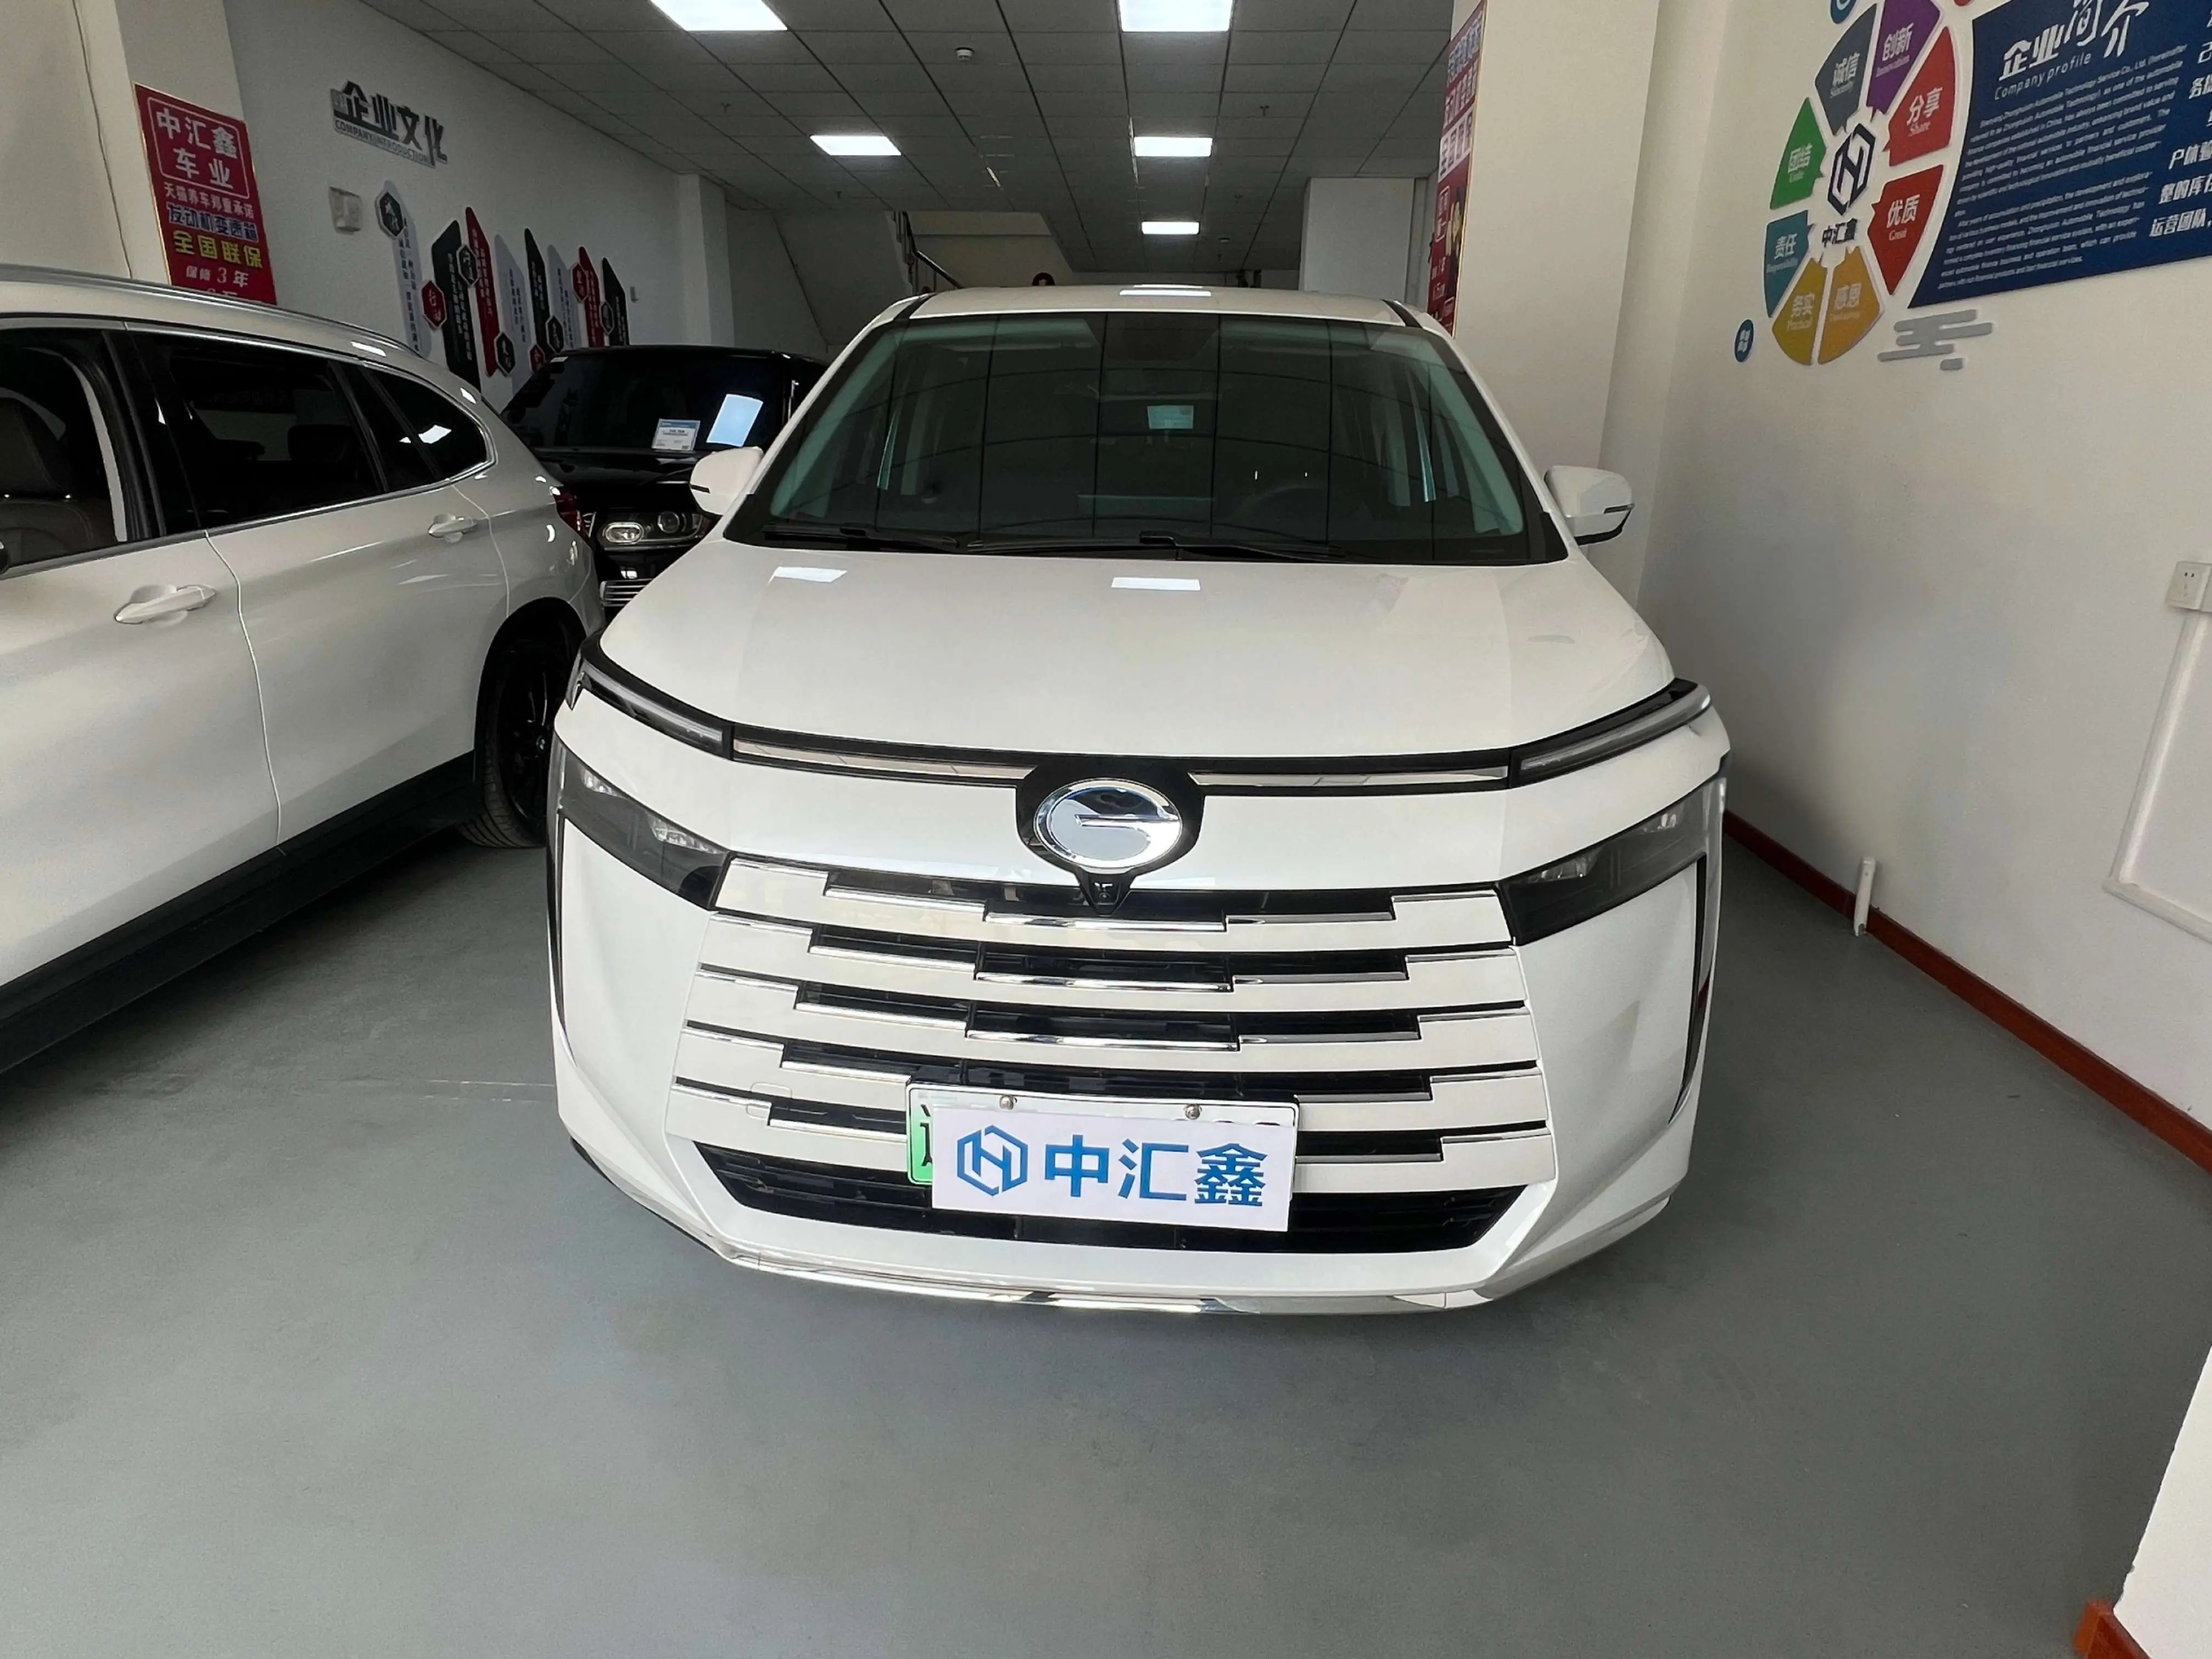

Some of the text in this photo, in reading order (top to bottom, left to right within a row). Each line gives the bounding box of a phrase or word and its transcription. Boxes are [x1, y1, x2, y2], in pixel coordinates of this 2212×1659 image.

[1882, 22, 1914, 61] 创新
[1999, 0, 2149, 81] 企业简介
[1832, 52, 1860, 88] 诚信
[1994, 53, 2091, 100] Company profile
[342, 81, 447, 166] 企业文化
[1906, 87, 1943, 126] 分享
[156, 108, 238, 159] 中汇鑫
[335, 120, 373, 141] COMPANY
[173, 147, 233, 189] 车业
[1788, 143, 1813, 173] 团结
[166, 201, 259, 244] 发动机变速箱
[1887, 194, 1921, 229] 优质
[172, 230, 263, 268] 全国联保
[1774, 233, 1798, 260] 责任
[1045, 1134, 1268, 1207] 中汇鑫
